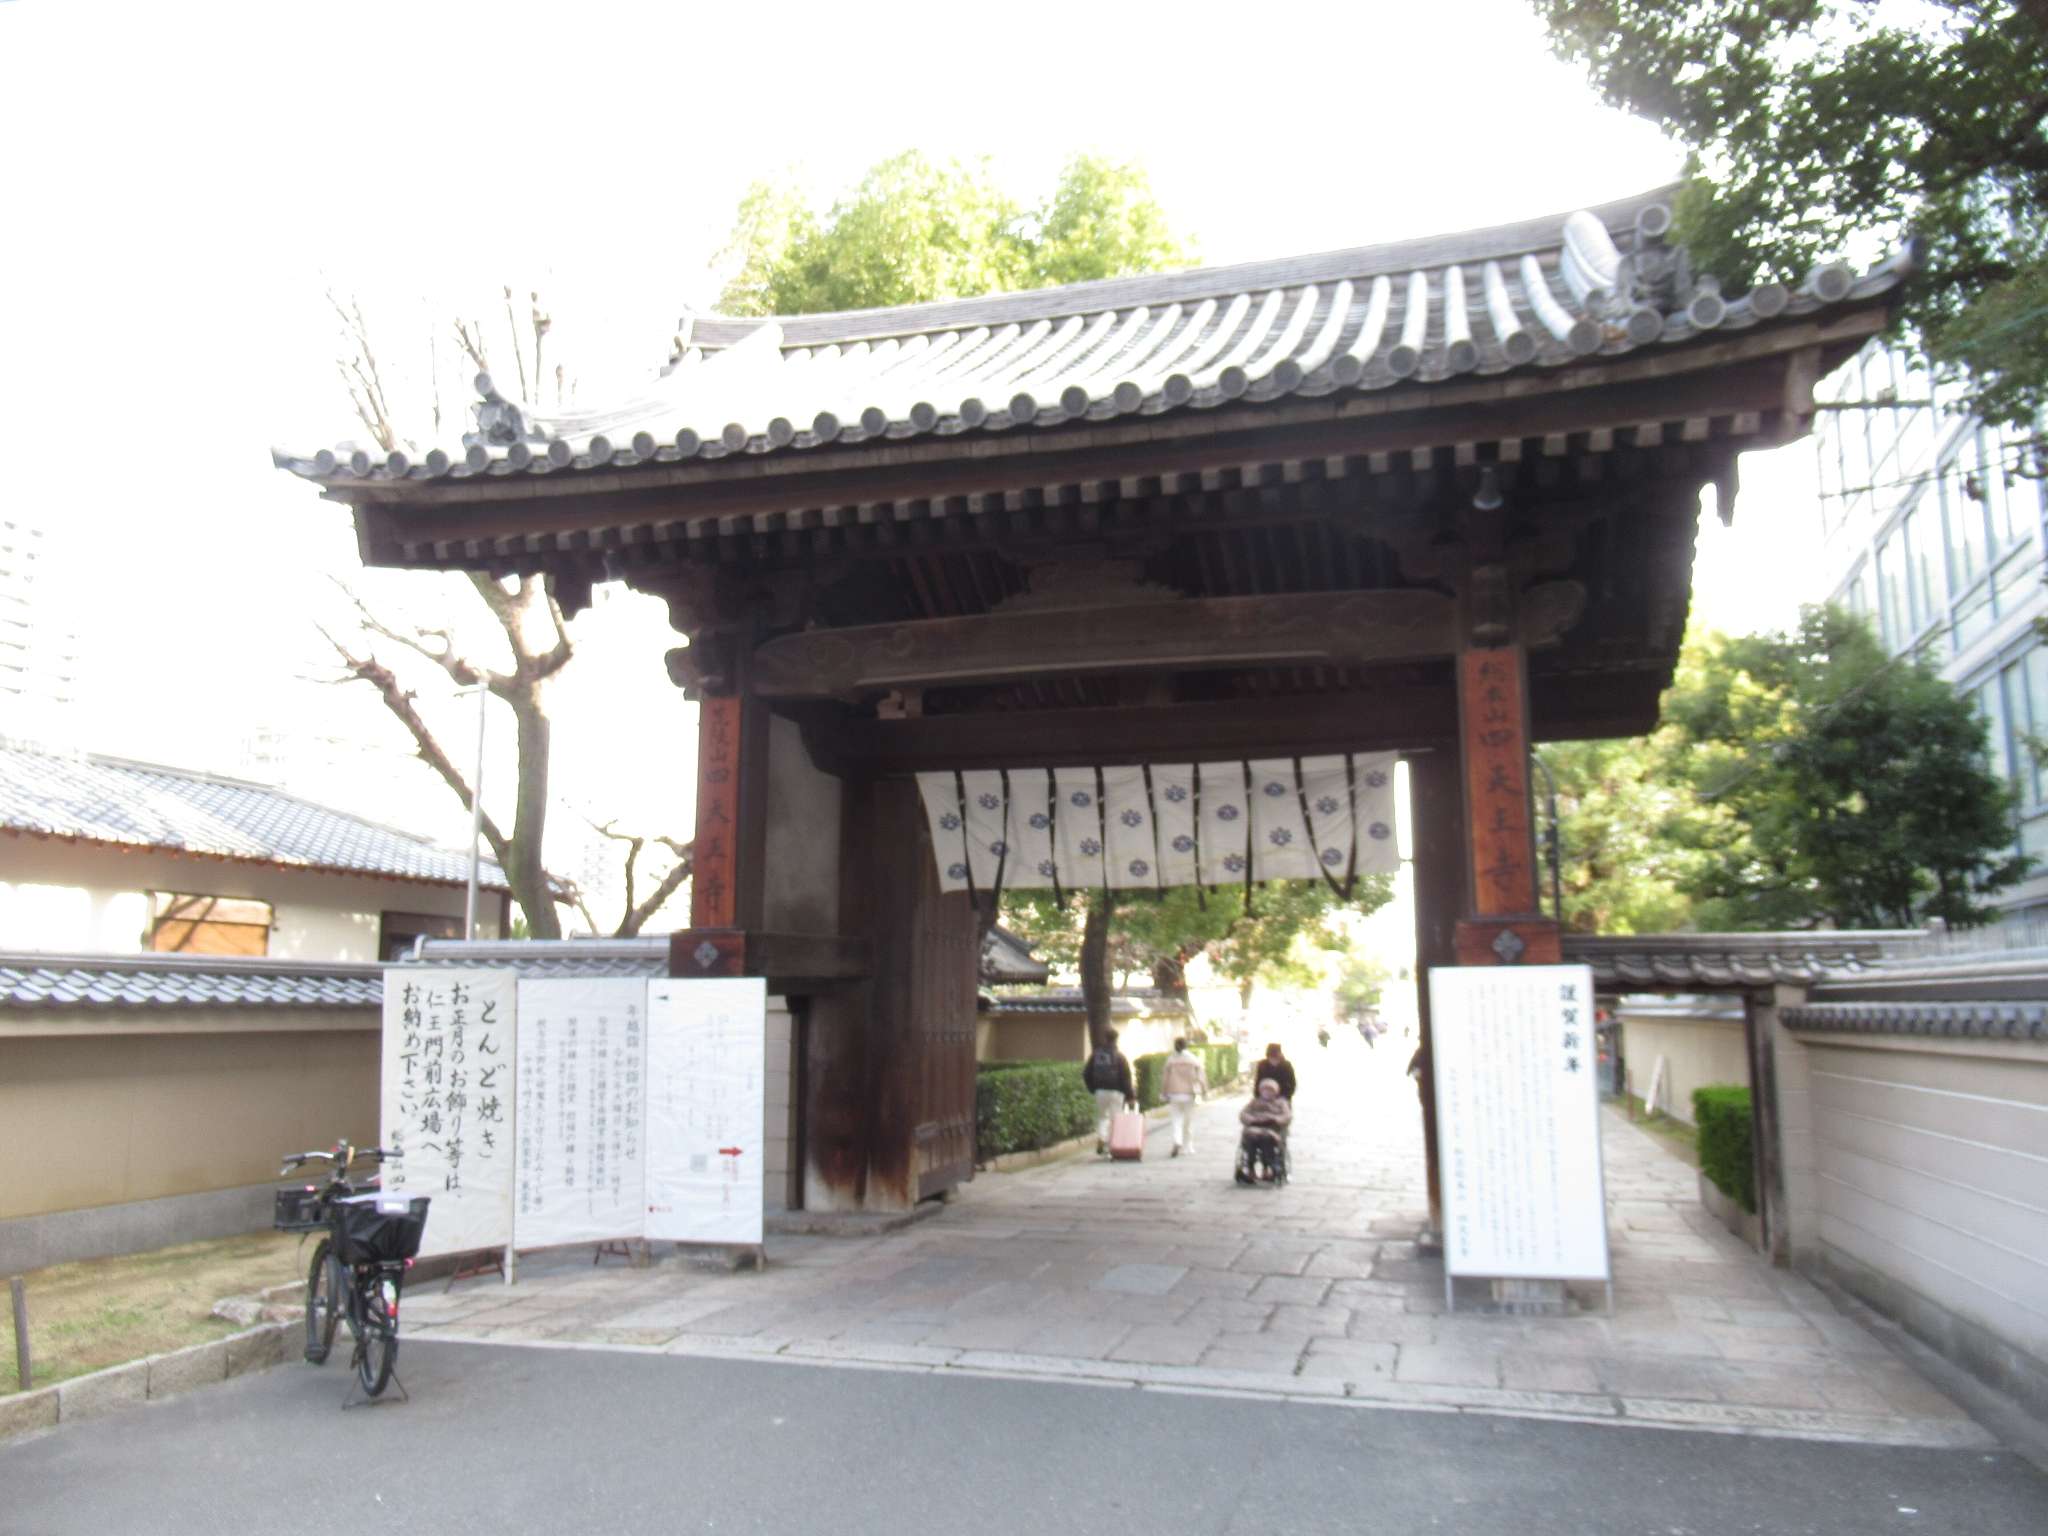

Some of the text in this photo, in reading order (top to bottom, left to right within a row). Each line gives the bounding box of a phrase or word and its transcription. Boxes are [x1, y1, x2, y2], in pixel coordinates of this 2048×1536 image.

[420, 991, 445, 1152] 仁王門前広場へ
[477, 999, 507, 1160] とんど焼き
[1559, 984, 1582, 1074] 謹賀新年
